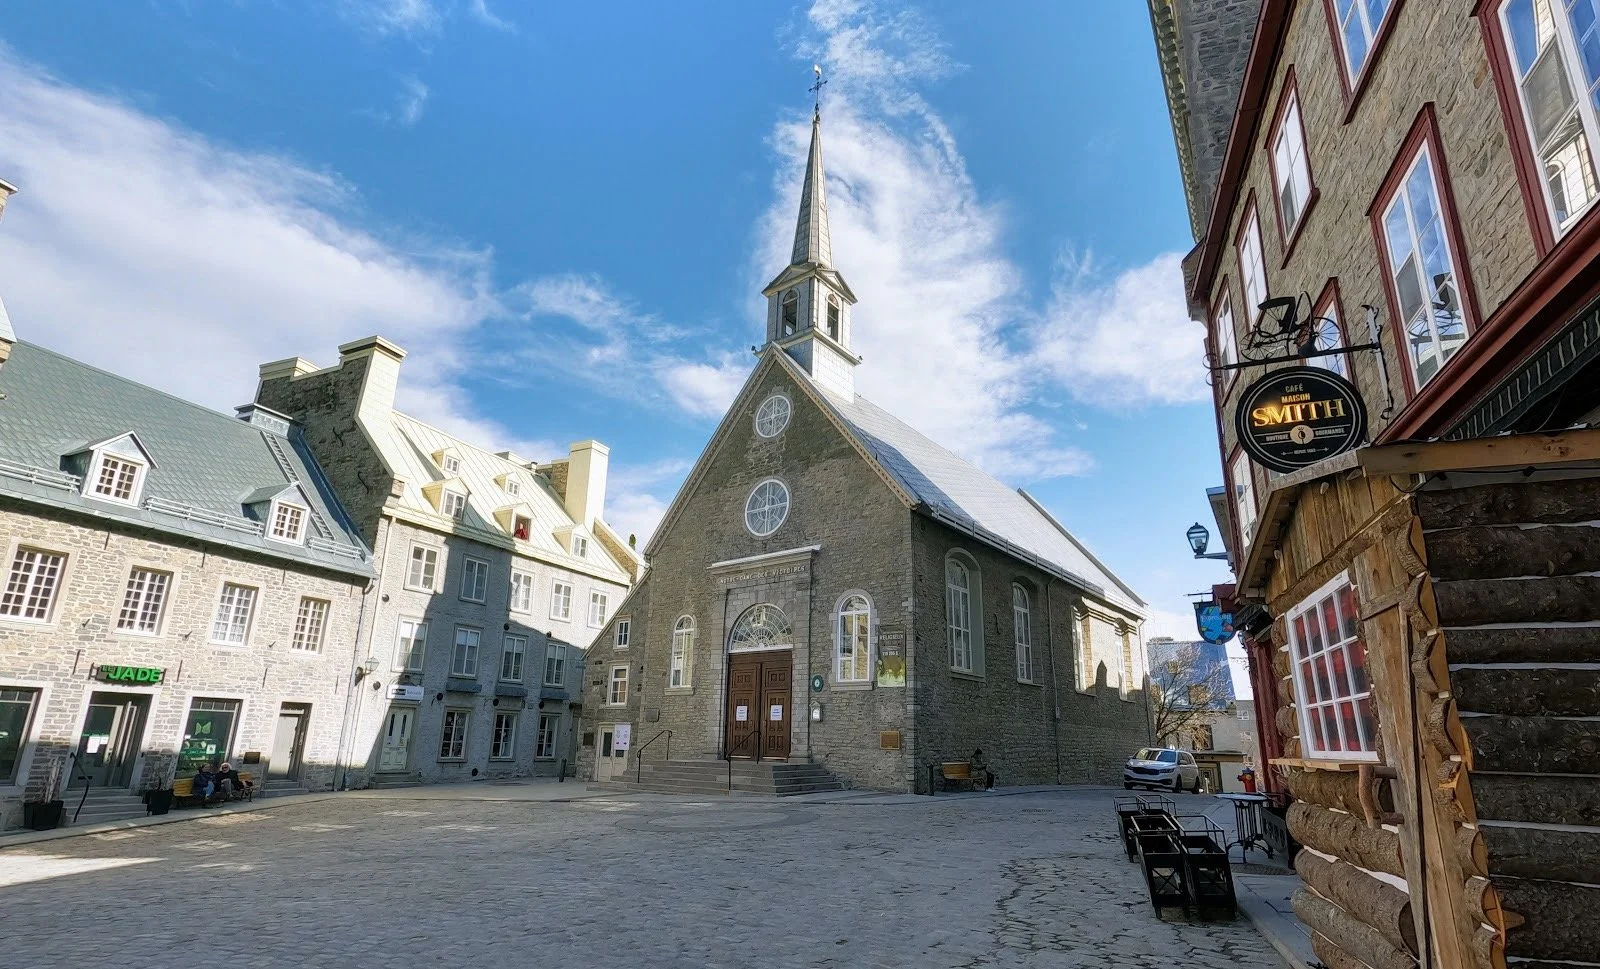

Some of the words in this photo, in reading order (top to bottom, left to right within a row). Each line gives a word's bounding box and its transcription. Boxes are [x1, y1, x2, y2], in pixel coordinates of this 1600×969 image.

[1281, 393, 1311, 404] MAISON
[1252, 398, 1347, 427] SMITH
[108, 665, 162, 682] JADE
